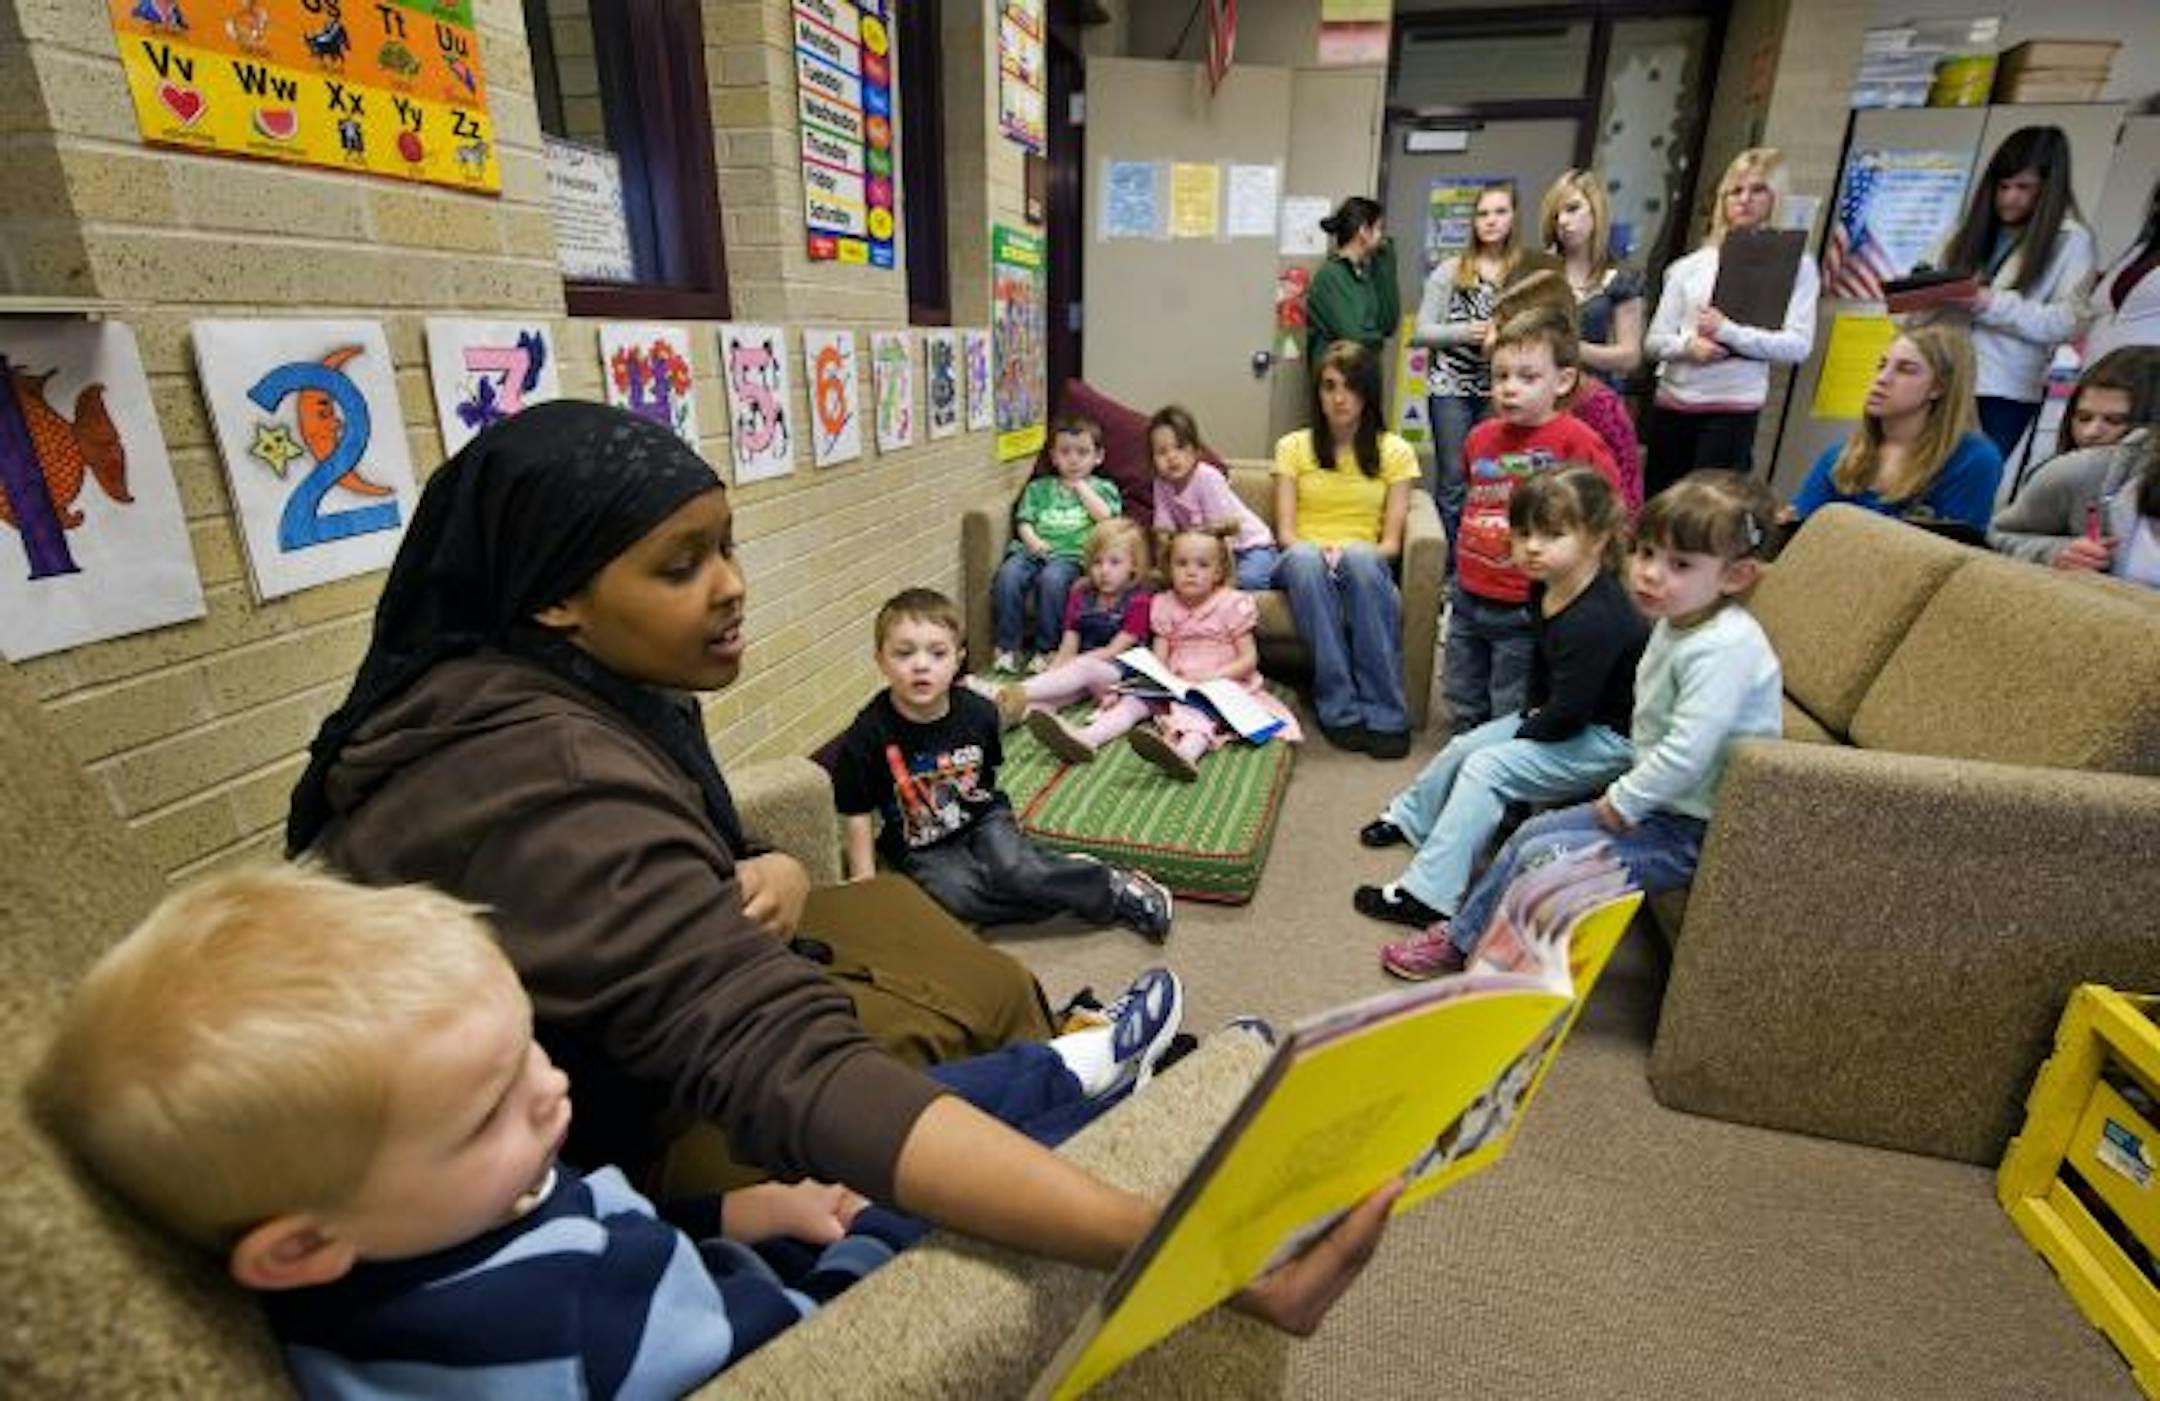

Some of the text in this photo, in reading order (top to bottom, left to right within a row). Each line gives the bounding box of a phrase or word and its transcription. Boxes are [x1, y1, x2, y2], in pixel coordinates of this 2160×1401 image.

[376, 3, 406, 38] Tt
[435, 21, 468, 55] Uu
[141, 40, 481, 139] Vv Ww Xx Yy Zz
[815, 343, 846, 434] 6
[247, 361, 402, 553] 2
